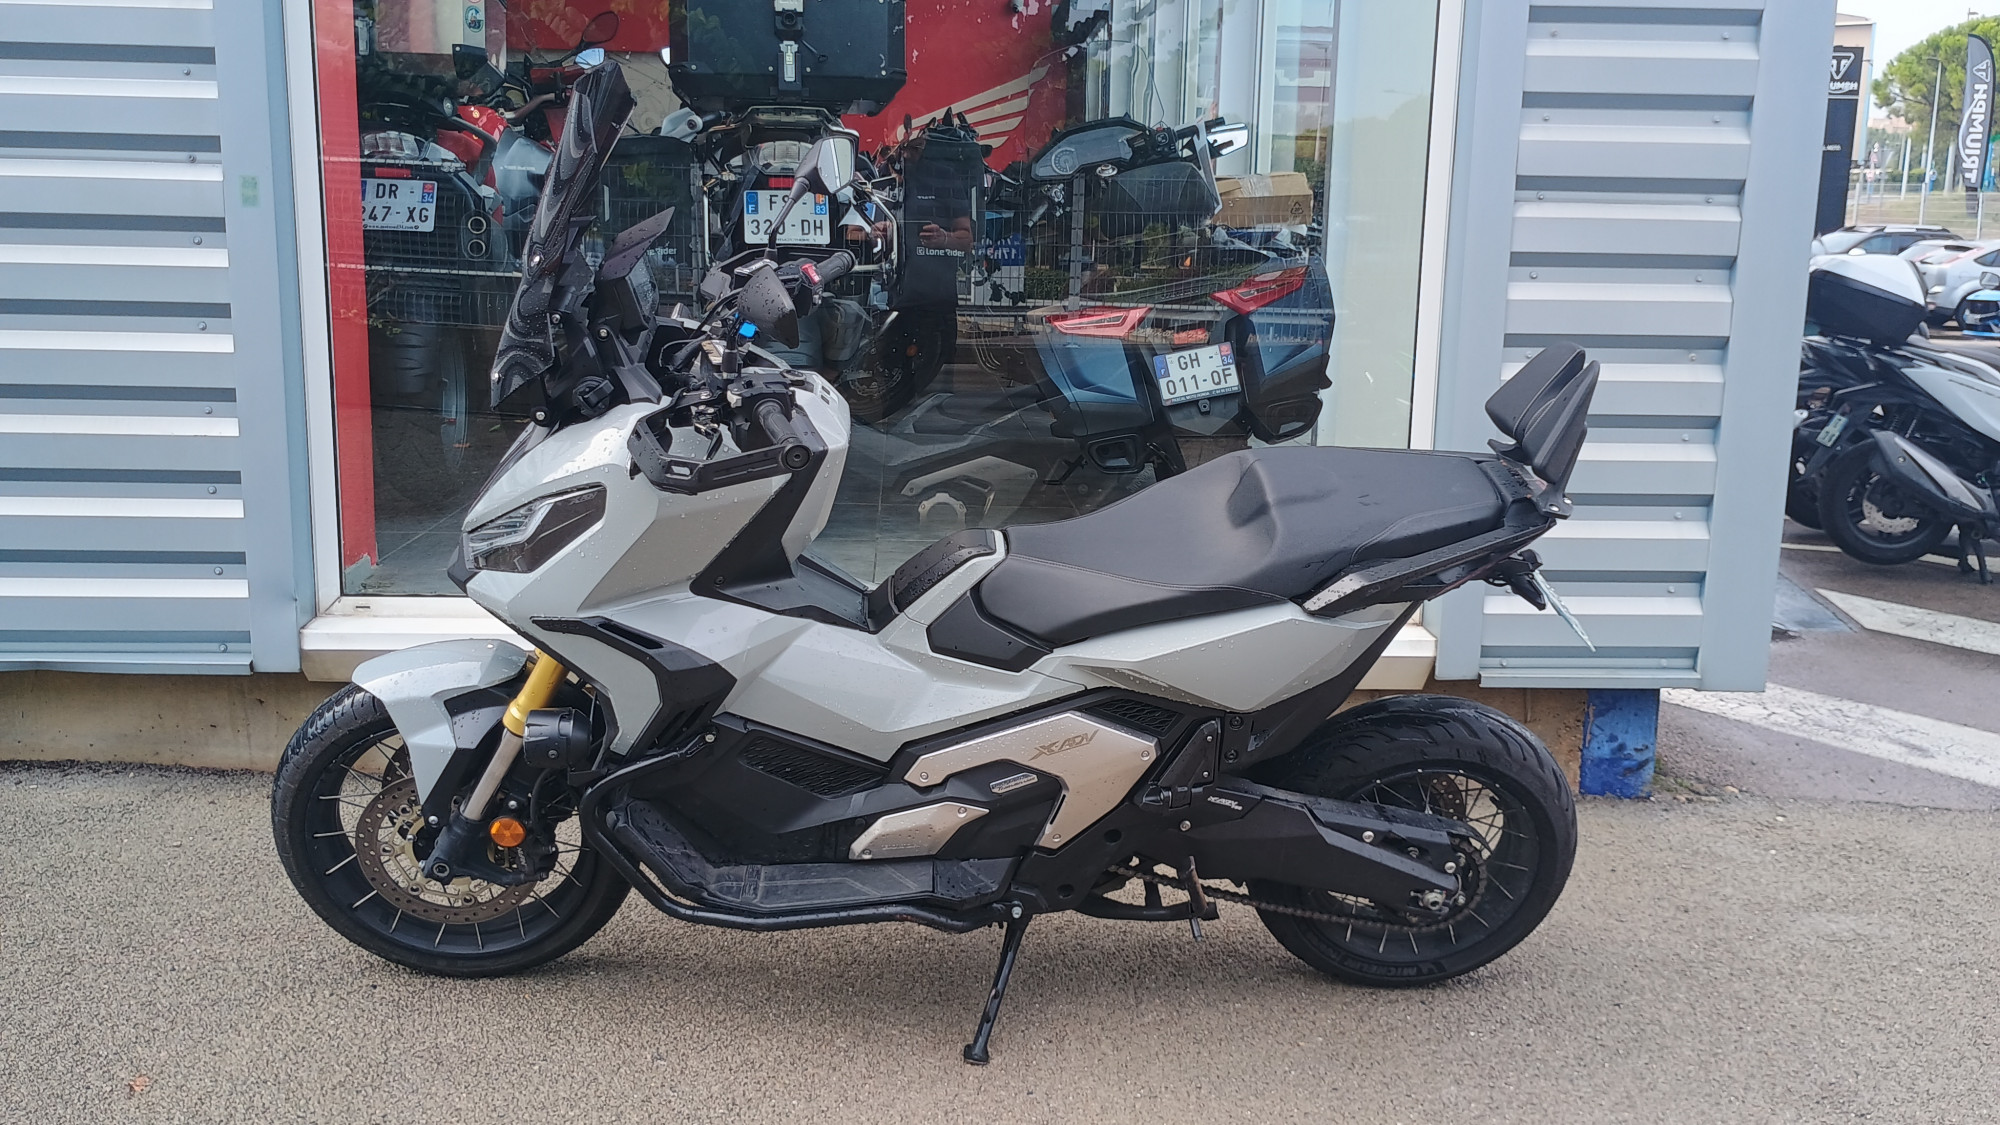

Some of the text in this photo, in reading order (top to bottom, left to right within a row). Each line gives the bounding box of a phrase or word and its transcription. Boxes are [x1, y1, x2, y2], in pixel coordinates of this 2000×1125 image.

[375, 183, 399, 199] DR
[422, 193, 433, 203] 34
[815, 205, 826, 214] 83
[926, 248, 965, 257] Lone Rider
[1177, 352, 1201, 371] GH
[1221, 355, 1233, 365] 34
[1343, 957, 1417, 976] MICHELIN
